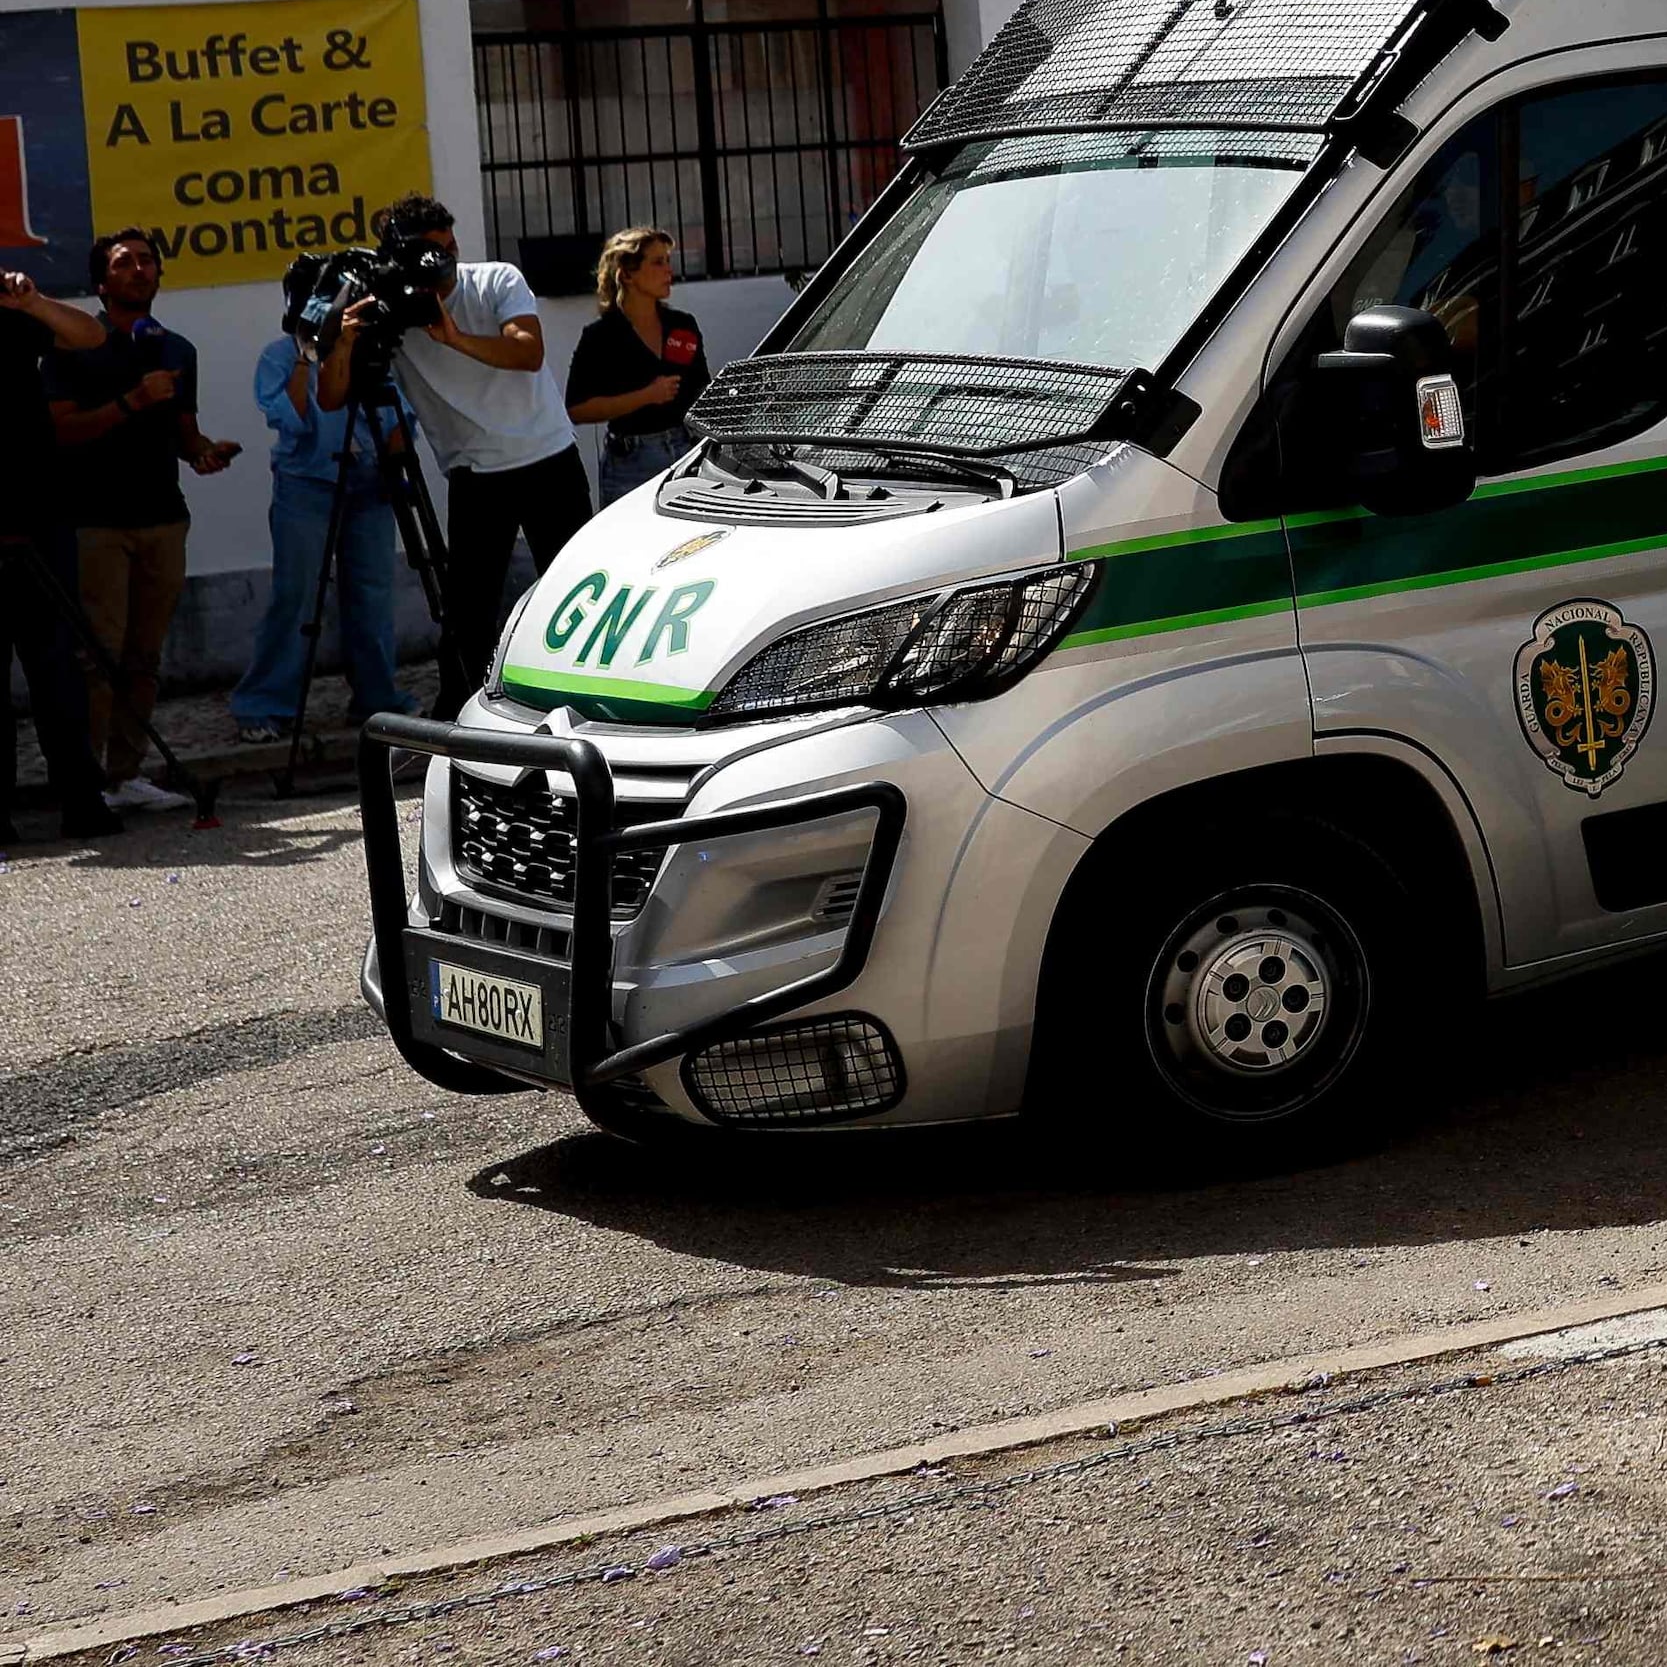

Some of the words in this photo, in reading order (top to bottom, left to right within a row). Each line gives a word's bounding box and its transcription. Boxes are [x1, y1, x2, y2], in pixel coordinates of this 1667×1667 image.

[125, 33, 306, 84] Buffet
[322, 28, 372, 72] &
[105, 103, 152, 148] A
[169, 100, 231, 143] La
[250, 90, 398, 136] Carte
[173, 162, 341, 207] coma
[543, 568, 719, 670] GNR
[1520, 673, 1540, 734] GUARDA
[1545, 607, 1612, 632] NACIONAL
[1629, 632, 1650, 736] REPUBLICANA
[448, 974, 534, 1040] AH80RX
